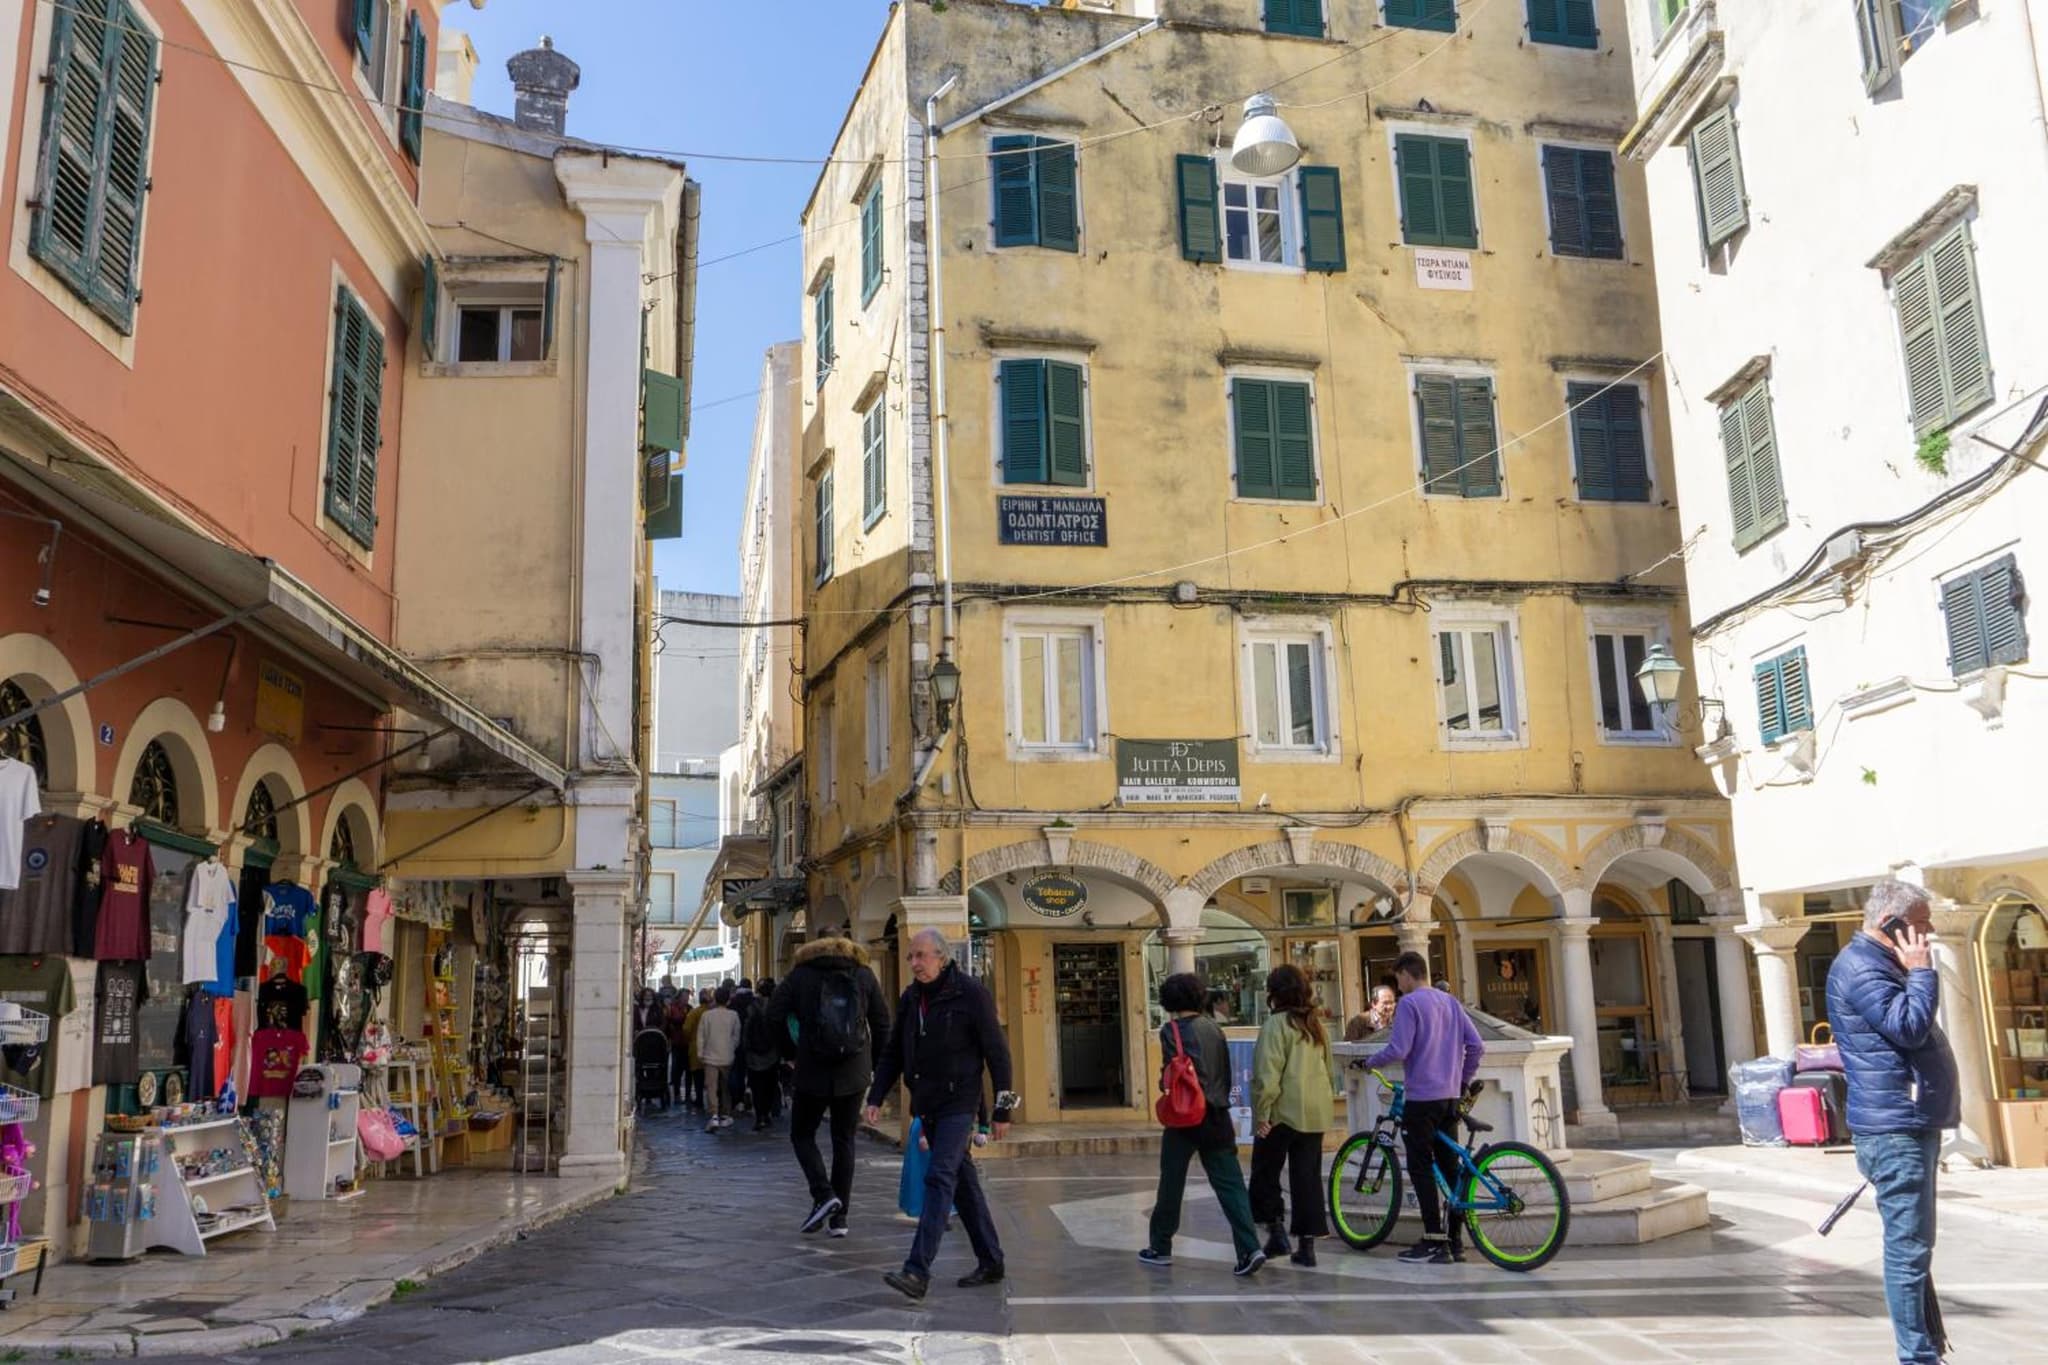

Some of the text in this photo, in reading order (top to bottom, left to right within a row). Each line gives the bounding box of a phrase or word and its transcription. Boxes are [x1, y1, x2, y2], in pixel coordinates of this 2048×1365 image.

[1002, 499, 1038, 512] ΕΙΡΗΝΗ
[1008, 513, 1099, 529] ΟΔΟΝΤΙΑΤΡΟΣ
[1014, 529, 1096, 542] DENTIST OFFICE
[1123, 777, 1176, 785] HAIR GALLERY
